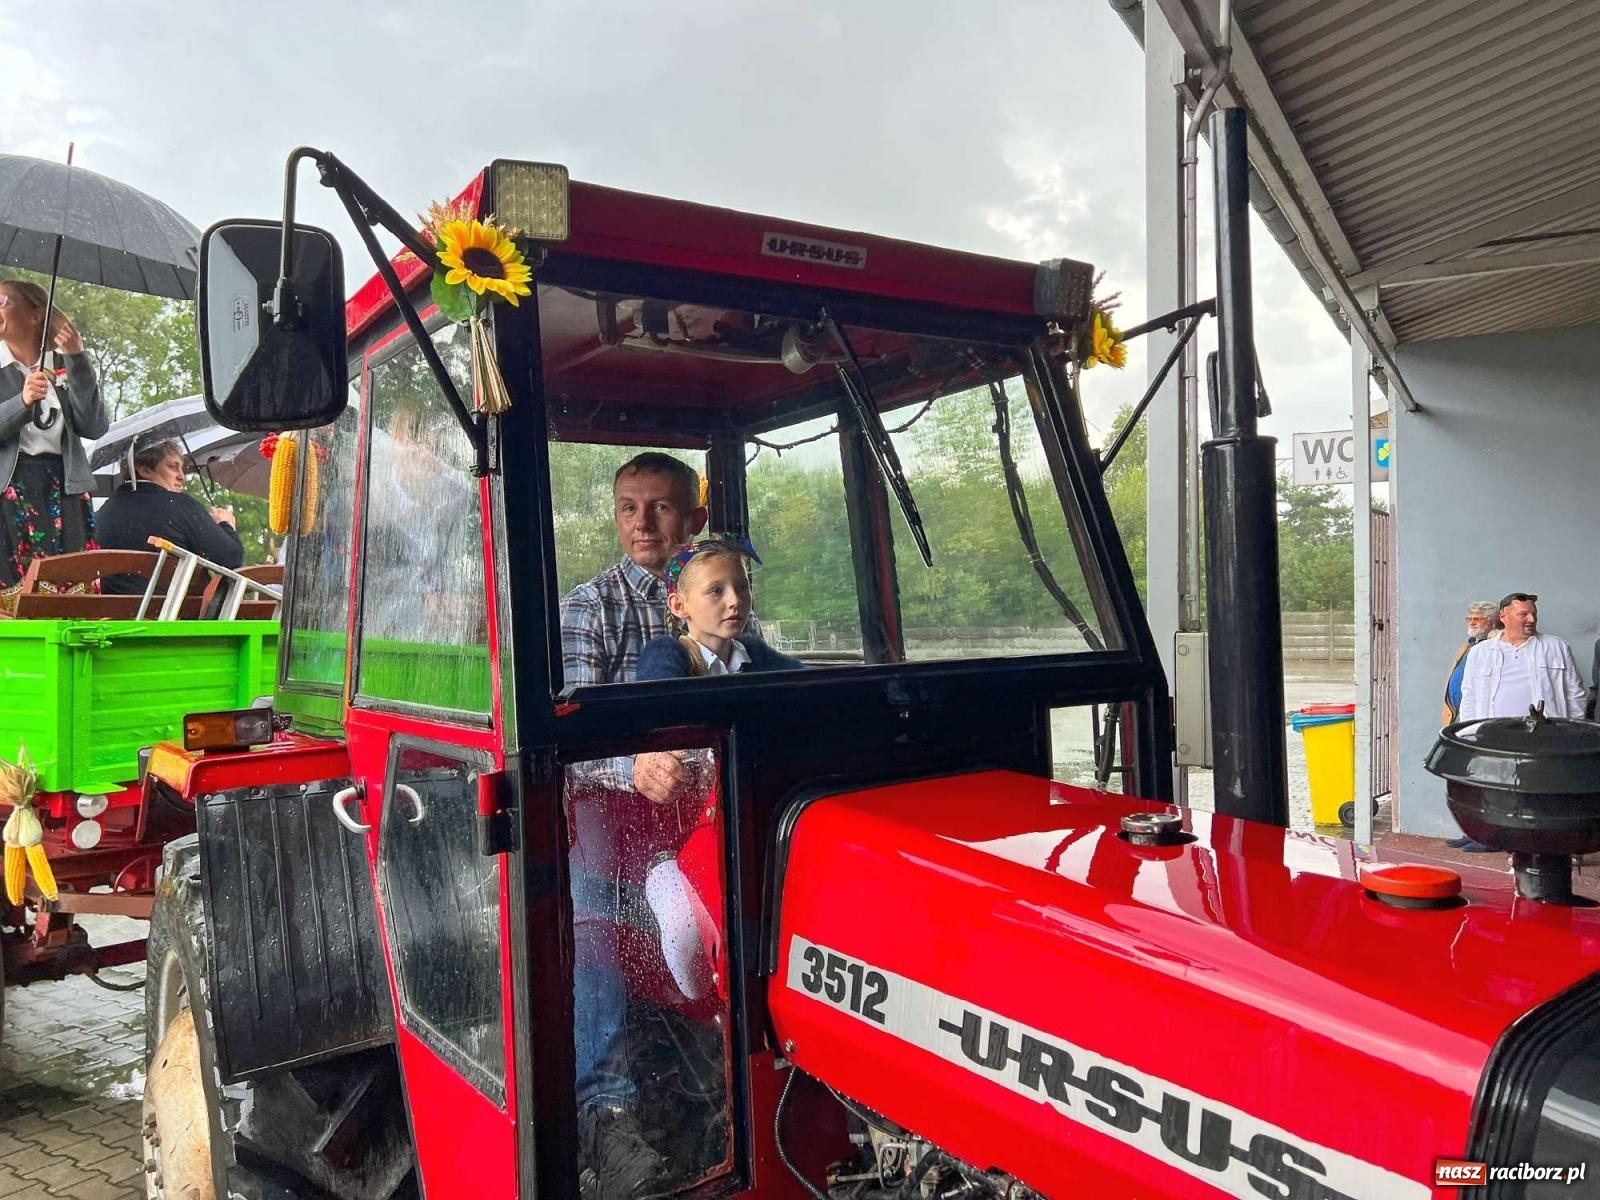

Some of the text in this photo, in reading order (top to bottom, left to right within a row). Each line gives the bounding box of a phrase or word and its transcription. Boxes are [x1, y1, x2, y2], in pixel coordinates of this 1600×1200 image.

[767, 237, 863, 265] URSUS
[1302, 436, 1353, 464] WC
[801, 946, 889, 1025] 3512
[939, 1009, 1345, 1200] URSUS
